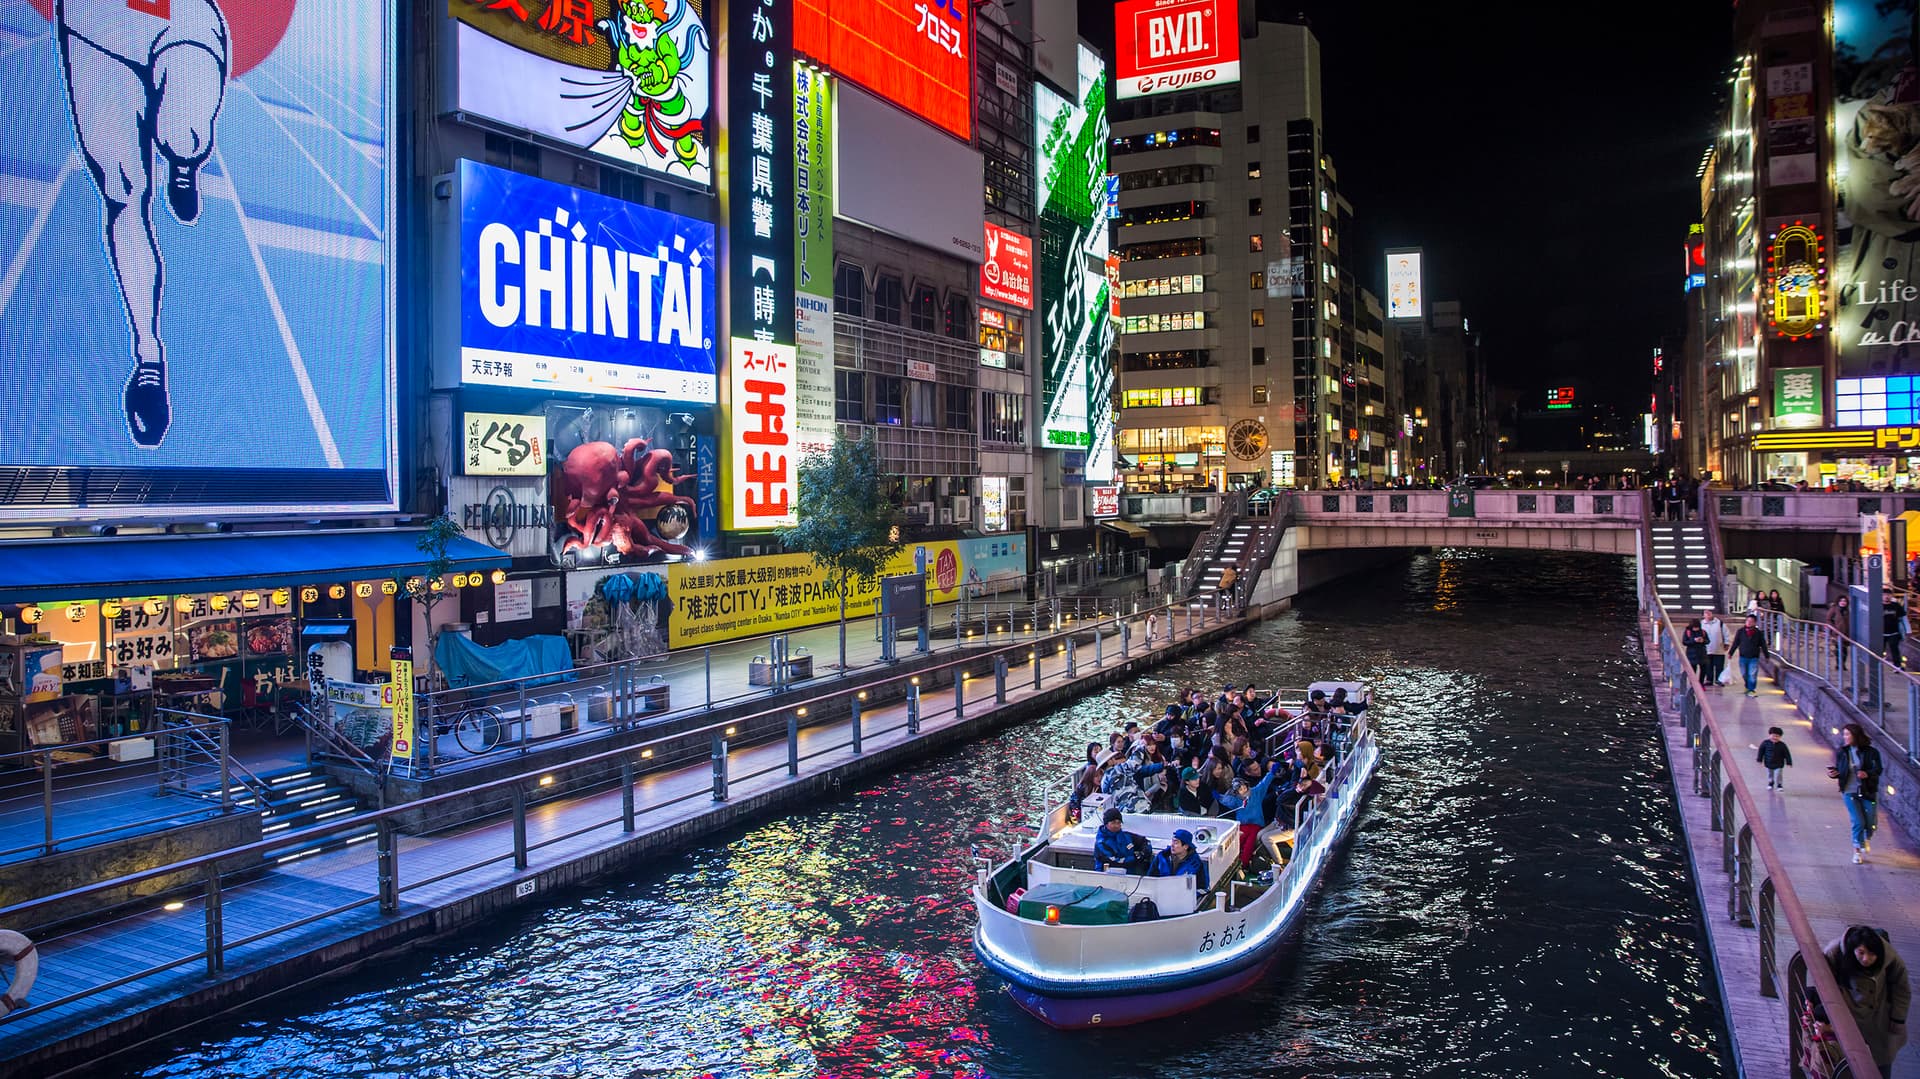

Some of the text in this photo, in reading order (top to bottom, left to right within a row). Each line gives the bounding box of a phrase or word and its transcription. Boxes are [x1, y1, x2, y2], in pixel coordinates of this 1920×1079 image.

[914, 3, 962, 59] プロミス
[1149, 11, 1209, 59] B.V.D.
[1157, 69, 1216, 89] FUJIBO
[796, 71, 811, 287] 株式会社日本リート
[479, 208, 703, 349] CHINTAI
[796, 296, 828, 313] NIHON
[1856, 279, 1918, 305] Life
[472, 359, 513, 377] 天気予報
[743, 350, 787, 374] スーパー
[1783, 373, 1813, 399] 薬
[480, 421, 531, 467] くくる
[742, 379, 789, 517] 玉出
[1876, 428, 1920, 448] ドン
[939, 553, 953, 573] TAX
[680, 565, 813, 590] 从这里到大阪最大级别的购物中心
[938, 567, 956, 587] FREE
[680, 625, 700, 637] Largest
[701, 623, 714, 633] class
[715, 620, 736, 632] shopping
[737, 617, 752, 627] center
[753, 617, 758, 625] in
[803, 608, 811, 616] and
[117, 633, 172, 661] お好み
[32, 682, 57, 693] DRY
[395, 661, 405, 739] アサヒスーパードライ
[1199, 918, 1247, 953] おおえ
